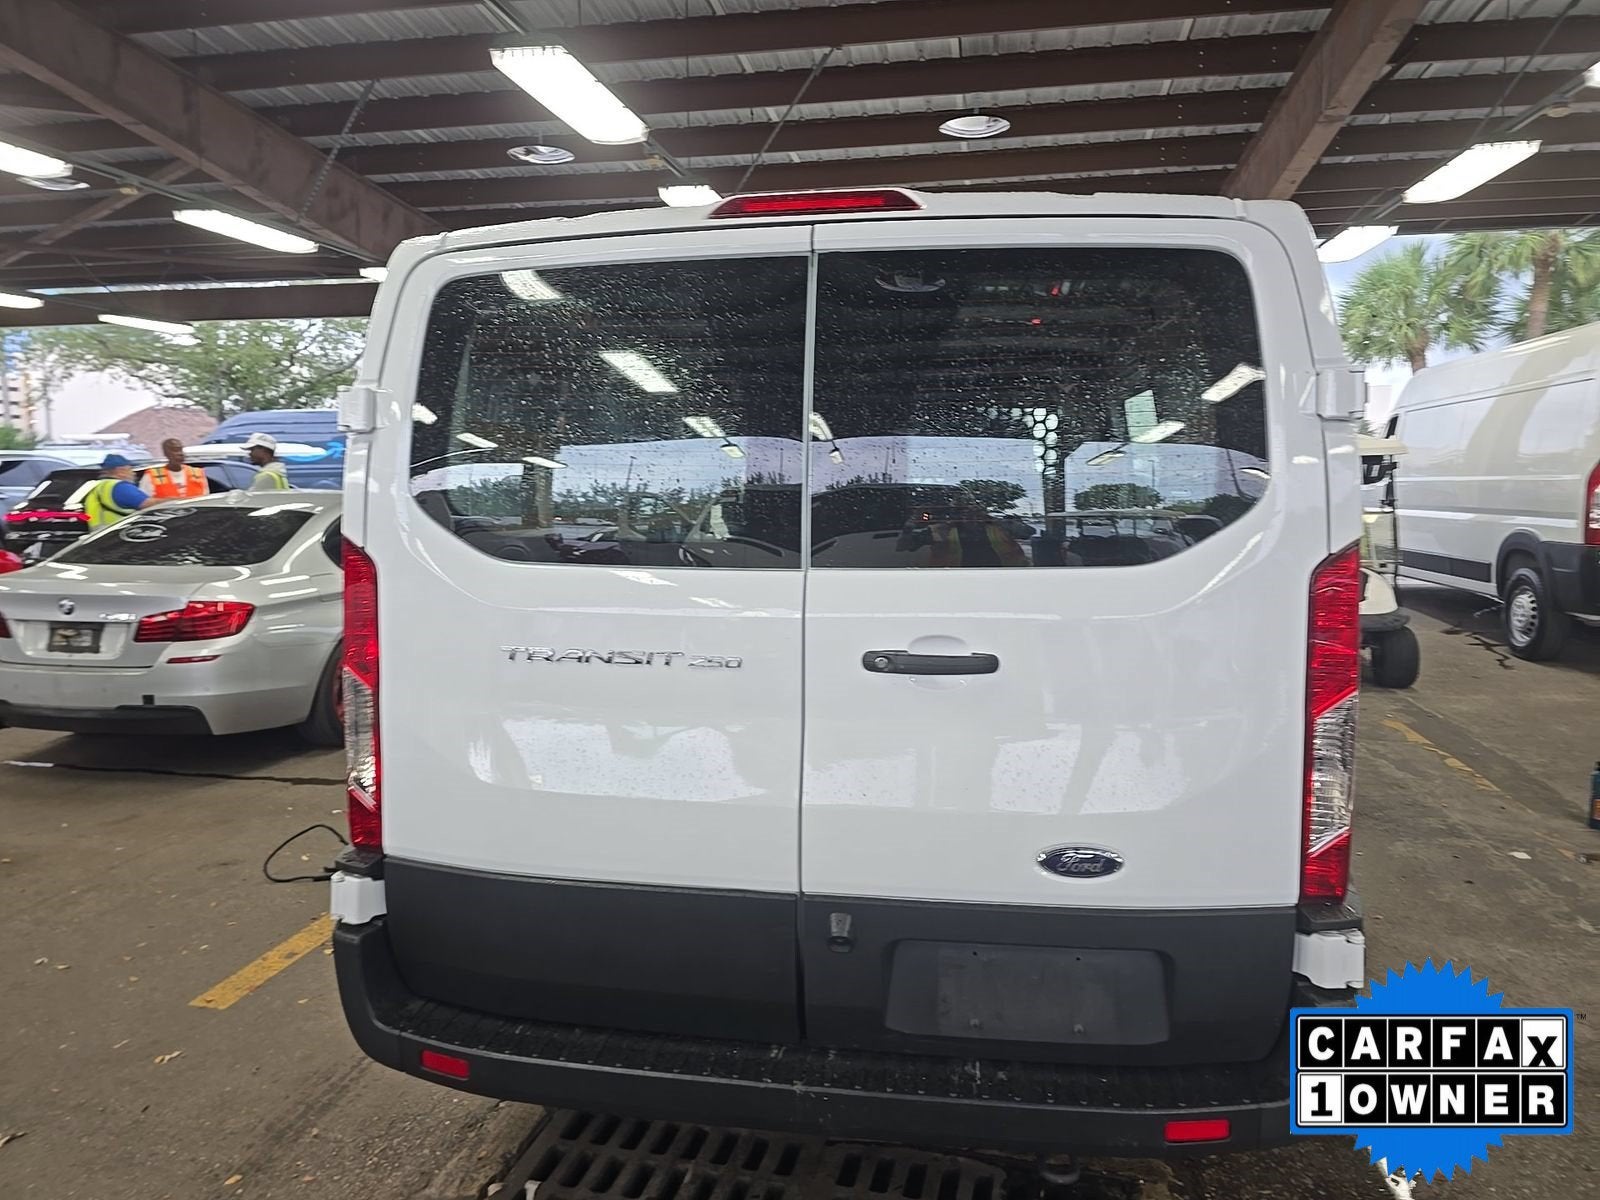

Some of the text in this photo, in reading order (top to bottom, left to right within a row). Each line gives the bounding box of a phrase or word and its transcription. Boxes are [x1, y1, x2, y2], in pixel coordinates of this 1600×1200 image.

[500, 645, 742, 669] TRANSIT 250
[1056, 853, 1106, 873] Ford
